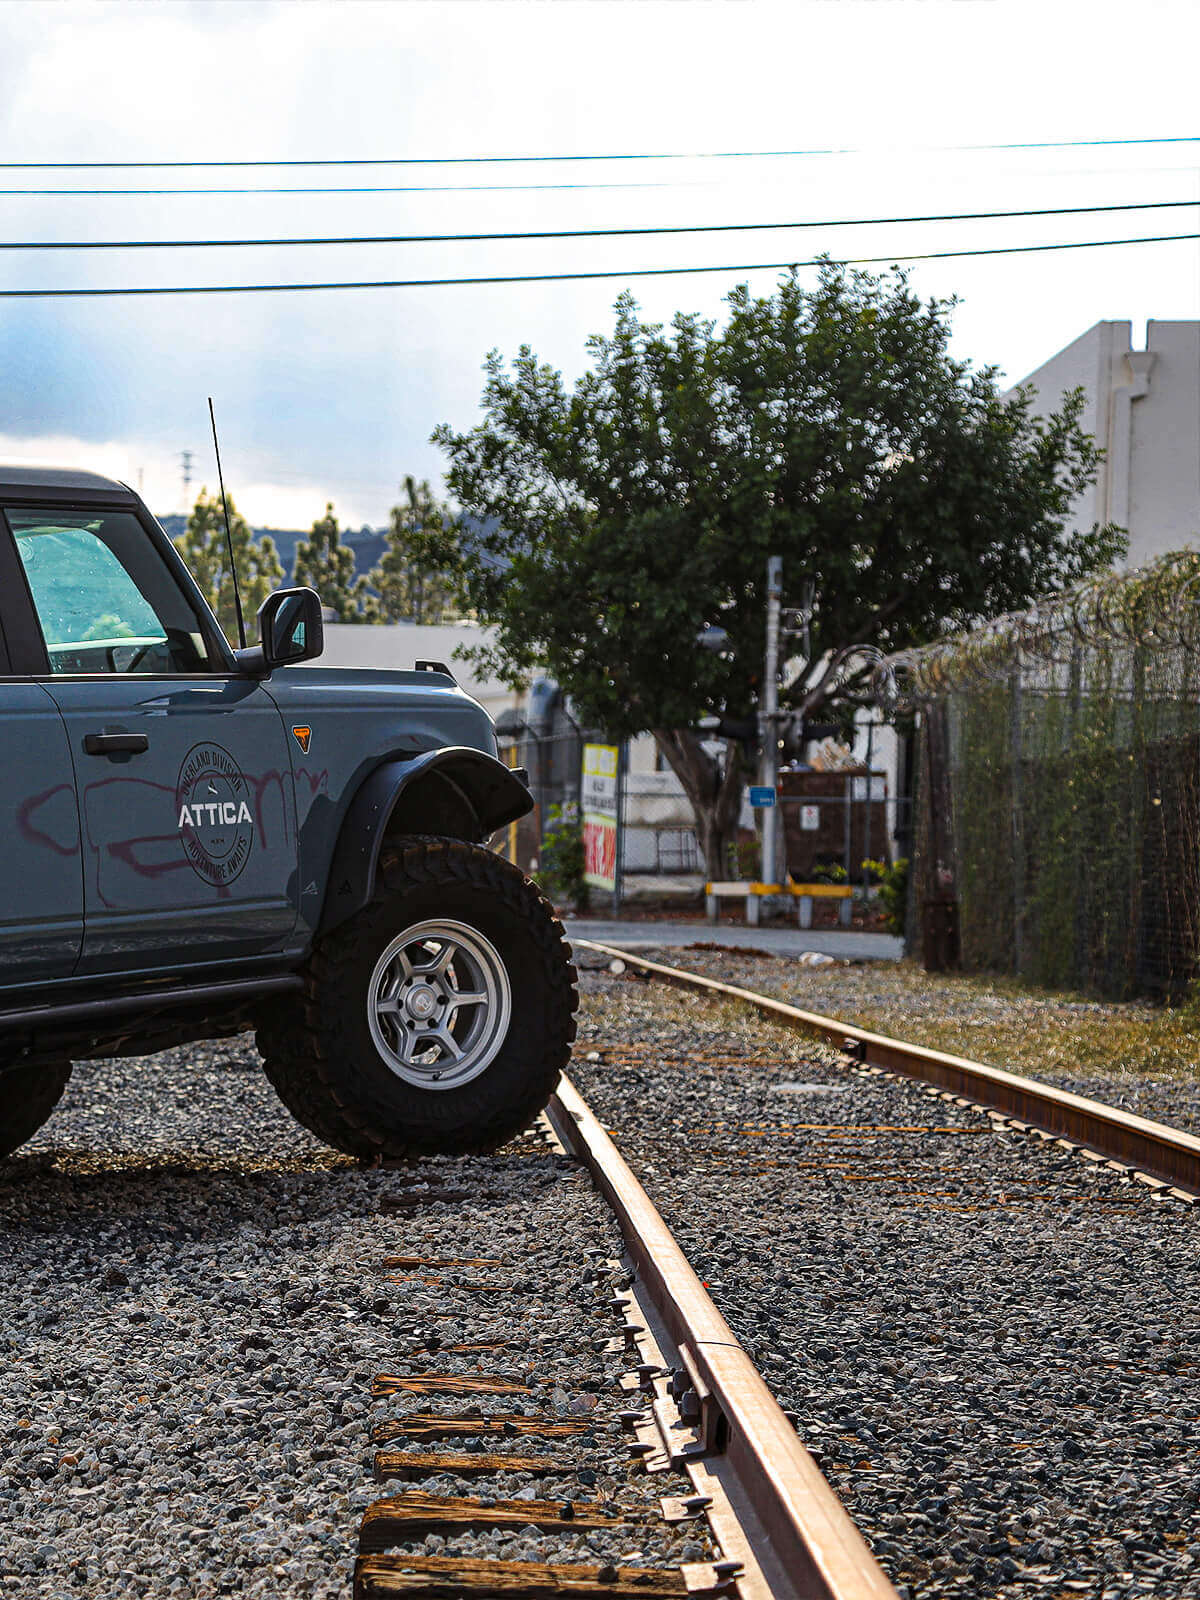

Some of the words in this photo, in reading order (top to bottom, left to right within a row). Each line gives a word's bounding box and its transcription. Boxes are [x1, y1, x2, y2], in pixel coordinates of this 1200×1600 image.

[184, 751, 211, 796] OVERLAND
[213, 752, 241, 792] DIVISION
[178, 801, 253, 828] ATTICA
[227, 836, 247, 874] AWAITS
